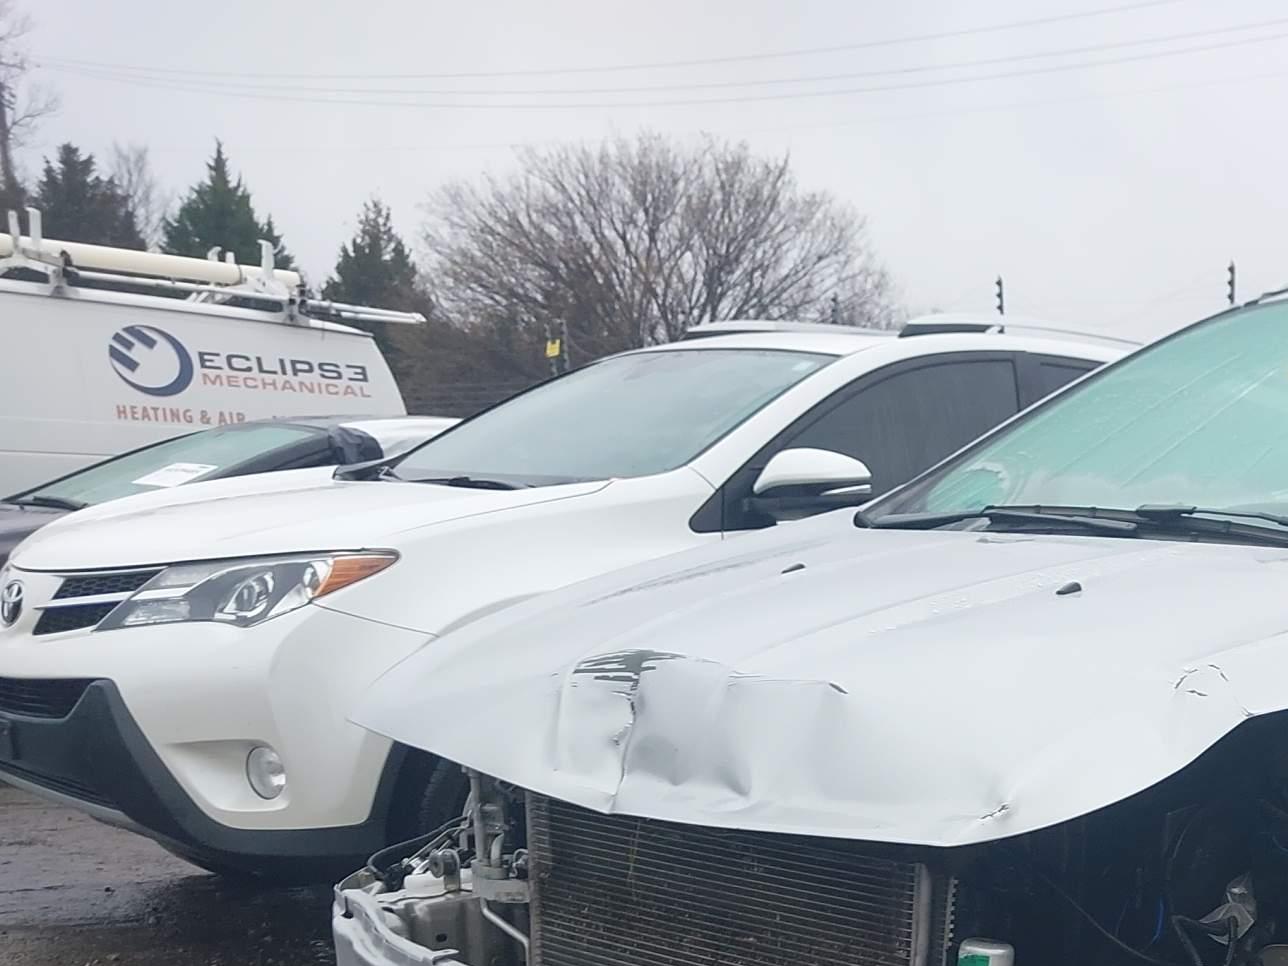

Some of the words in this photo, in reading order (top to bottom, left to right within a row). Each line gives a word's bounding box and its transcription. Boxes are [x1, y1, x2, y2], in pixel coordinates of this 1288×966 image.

[202, 372, 372, 398] MECHANICAL
[116, 404, 193, 424] HEATING
[199, 409, 211, 425] &
